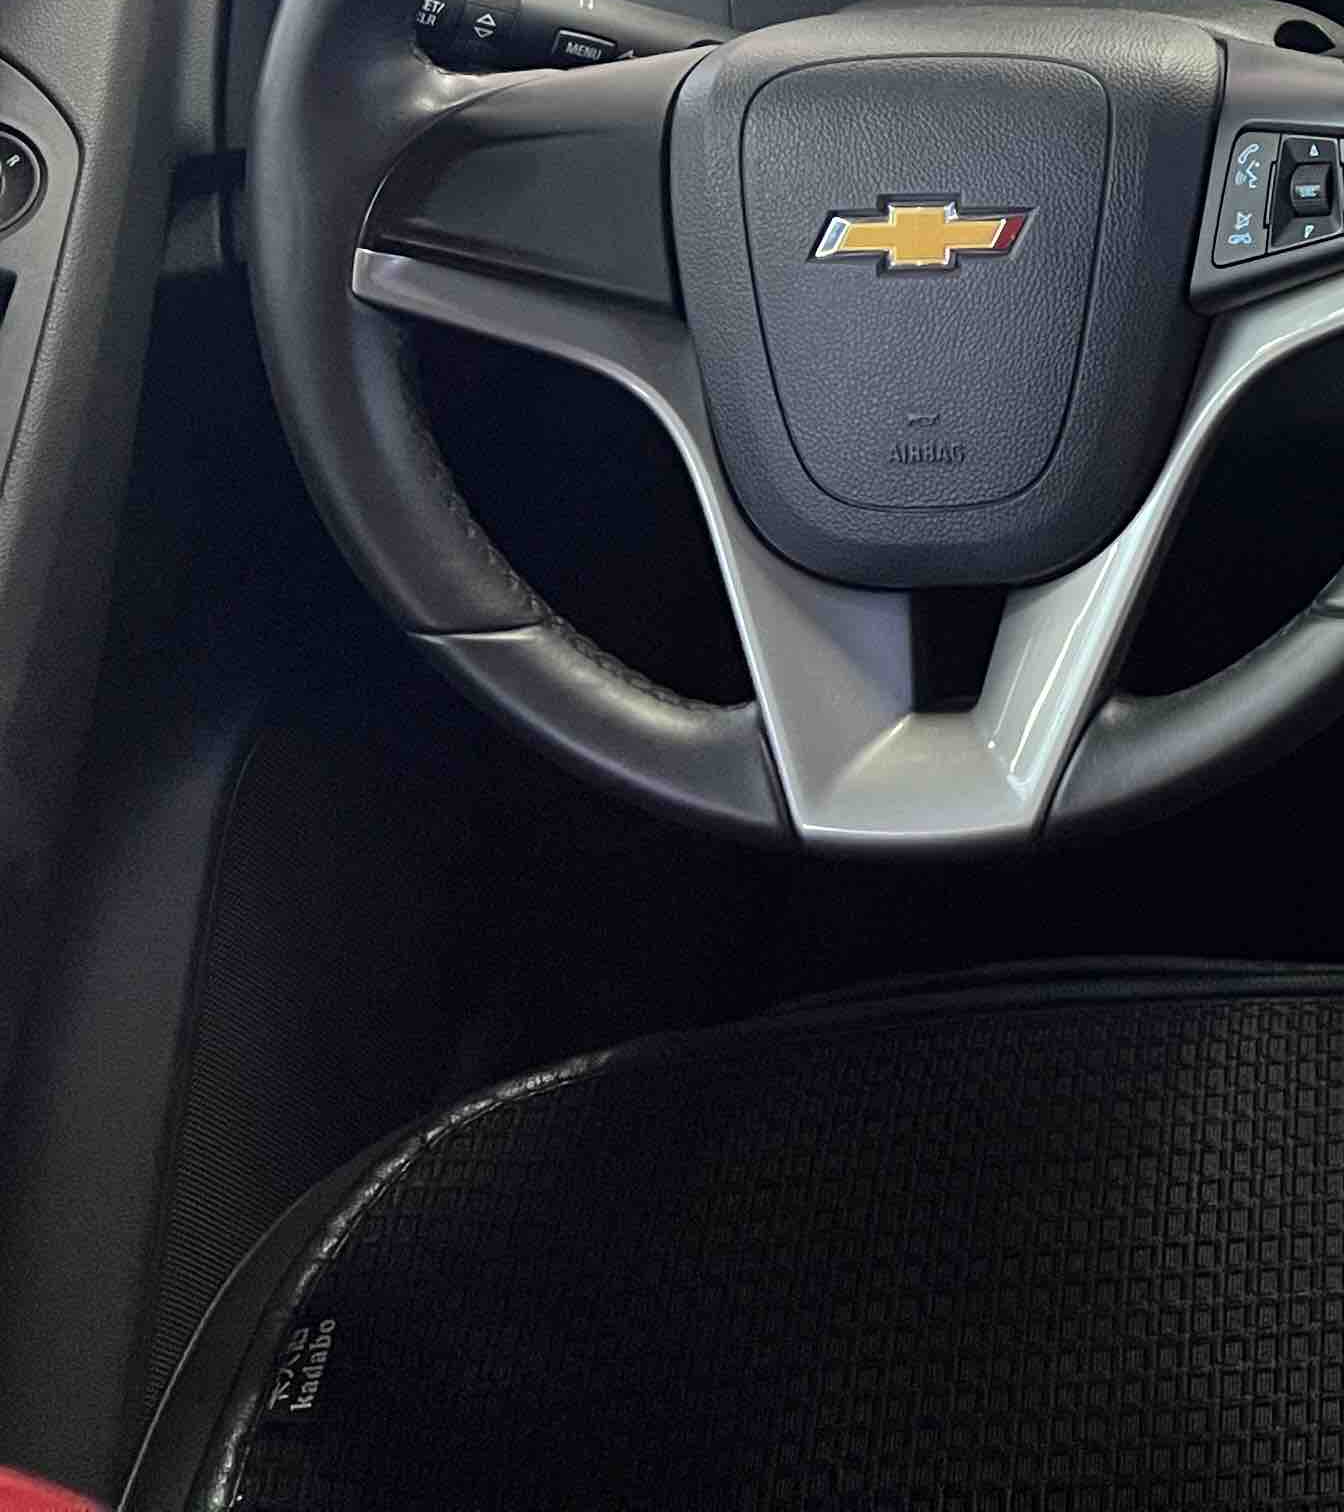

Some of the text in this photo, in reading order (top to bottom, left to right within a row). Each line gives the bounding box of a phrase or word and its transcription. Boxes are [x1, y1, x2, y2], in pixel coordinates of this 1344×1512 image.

[565, 41, 602, 60] MENU
[888, 444, 966, 465] AIRBAG
[290, 1319, 336, 1411] kadabo
